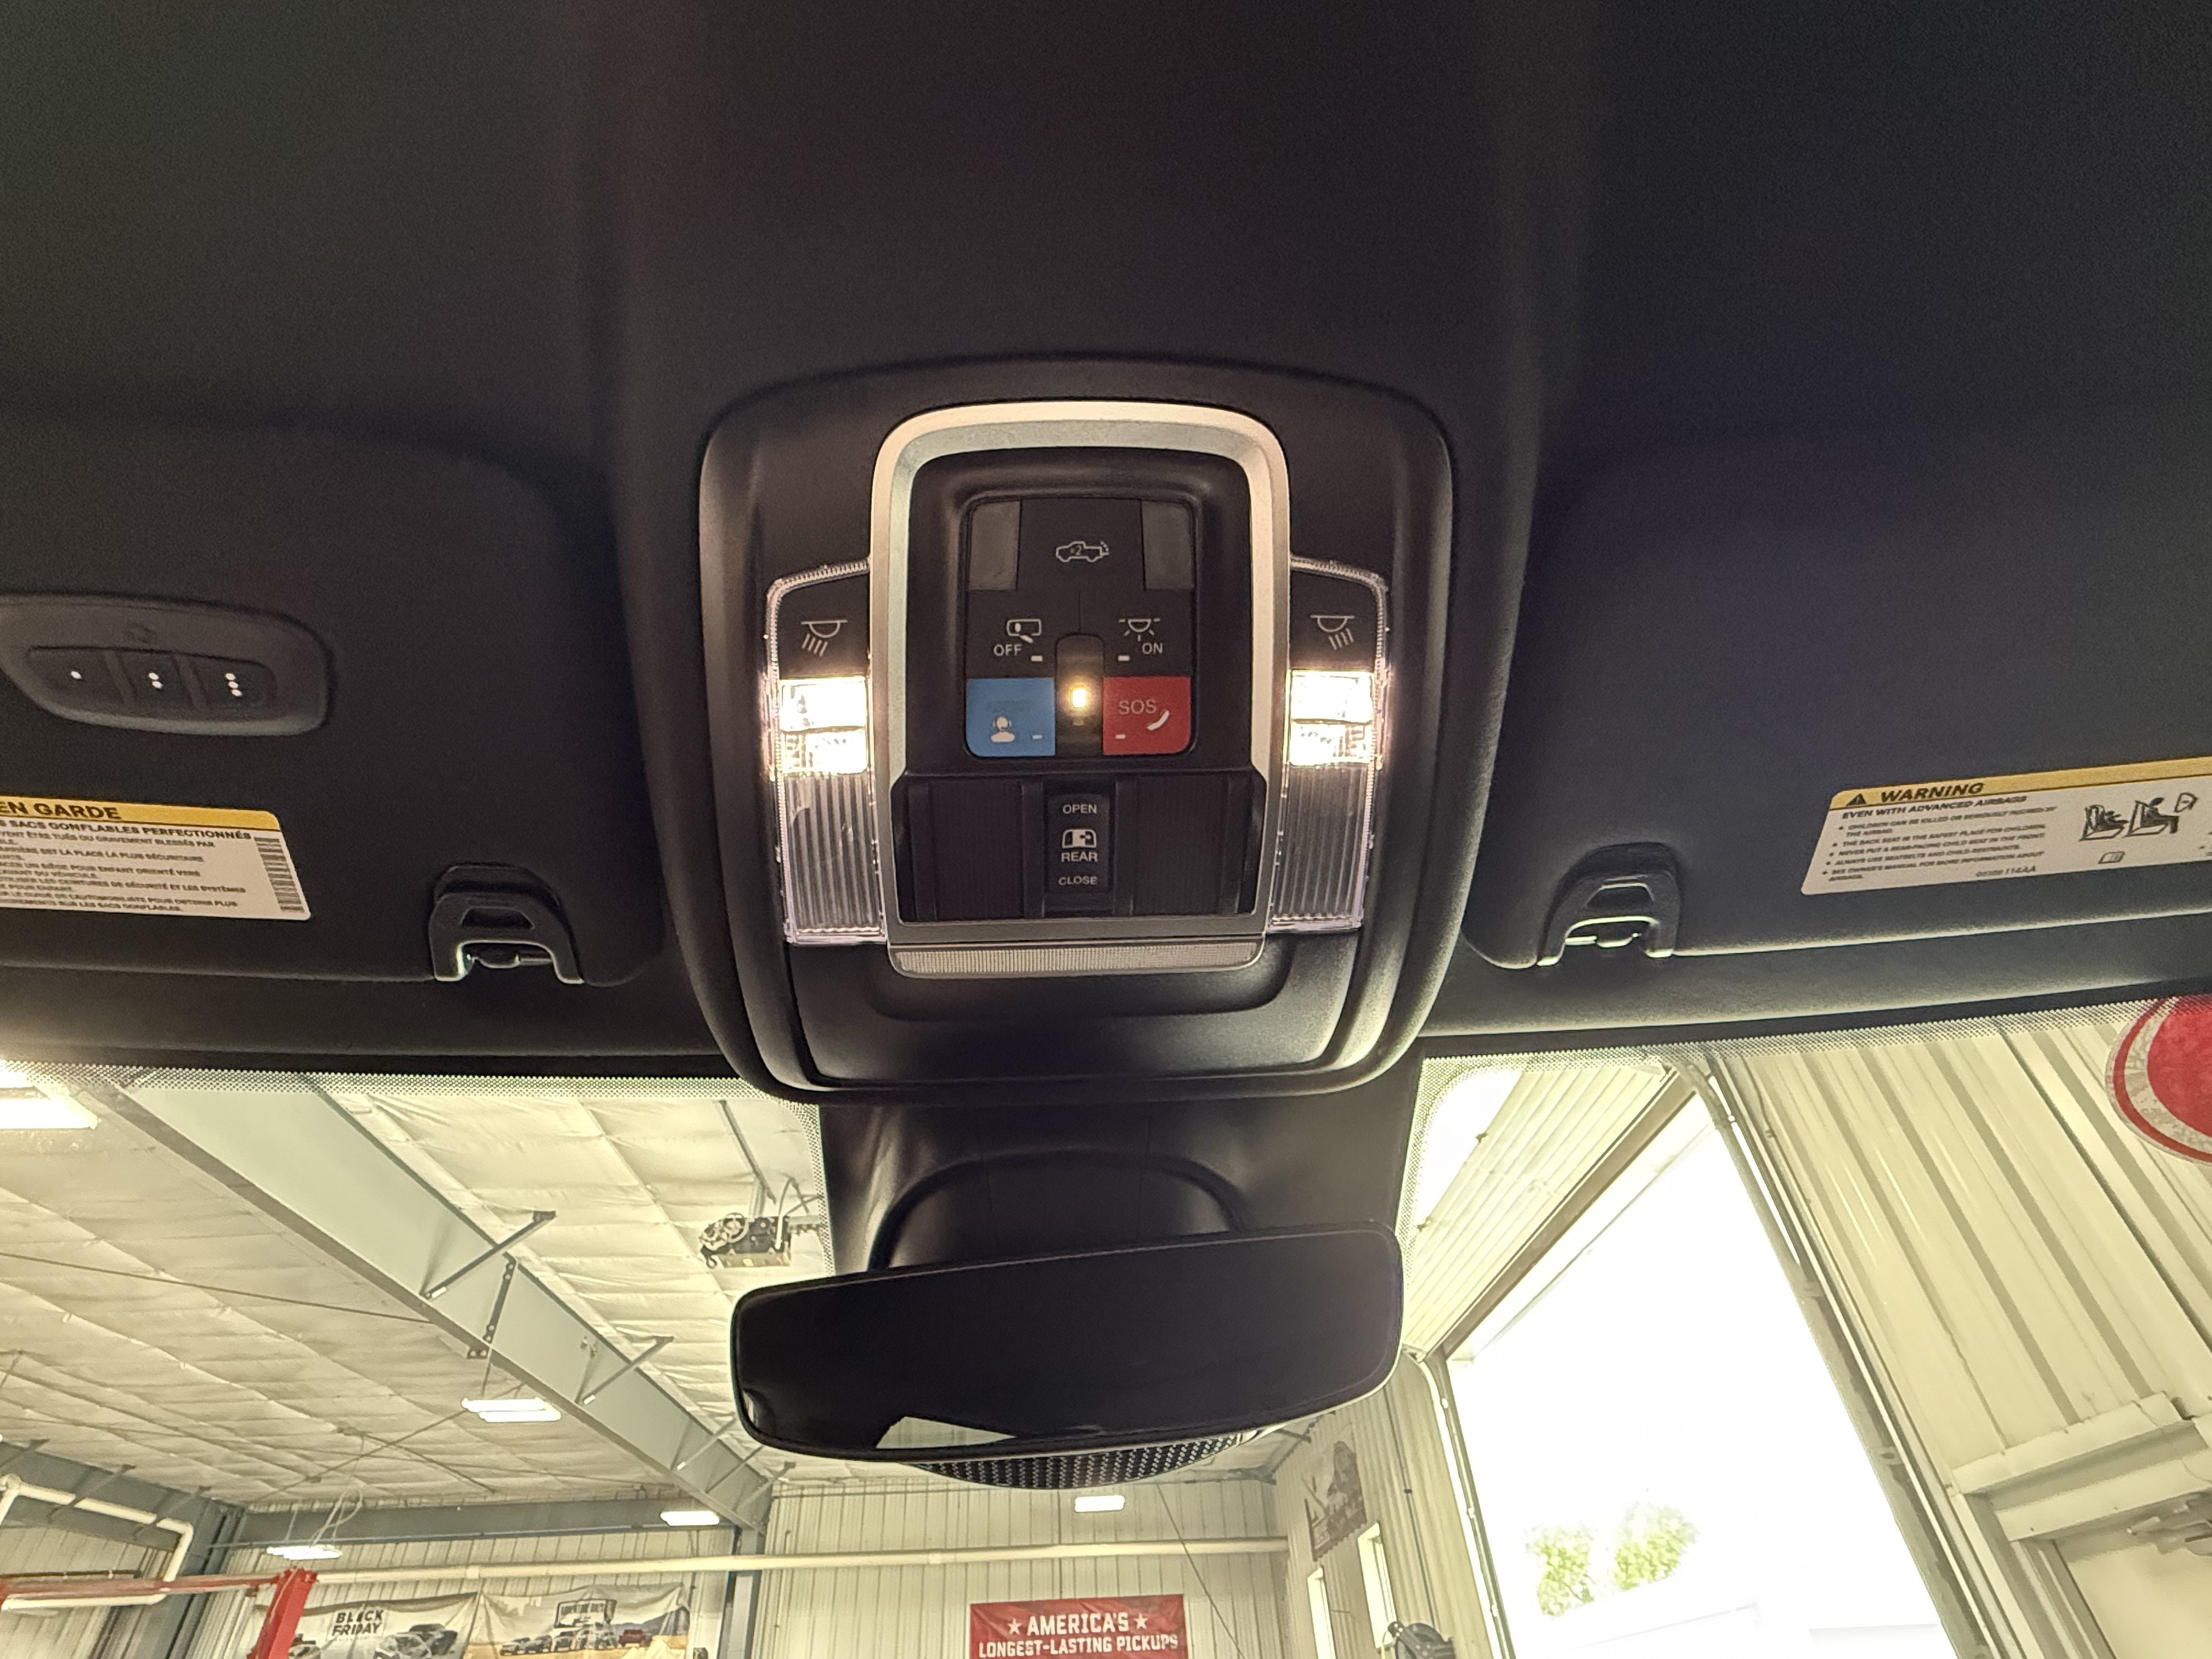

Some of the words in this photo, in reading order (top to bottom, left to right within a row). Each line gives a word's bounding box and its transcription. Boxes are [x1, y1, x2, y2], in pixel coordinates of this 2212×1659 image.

[994, 644, 1023, 656] OFF
[1142, 642, 1164, 654] ON
[1119, 699, 1157, 715] SOS
[1881, 782, 1984, 803] WARNING
[33, 803, 122, 820] GARDE
[1062, 804, 1097, 815] OPEN
[1842, 810, 1874, 819] EVEN
[1876, 807, 1906, 816] WITH
[1908, 800, 1974, 813] ADVANCED
[9, 820, 47, 830] SACS
[48, 822, 140, 834] GONFLABLES
[142, 827, 252, 840] PERFECTIONNÉS
[1061, 851, 1098, 862] REAR
[1058, 876, 1098, 885] CLOSE
[331, 1622, 382, 1637] FRIDAY
[1026, 1612, 1129, 1636] AMERICA'S
[979, 1637, 1113, 1658] LONGEST-LASTING
[1116, 1634, 1178, 1652] PICKUPS
